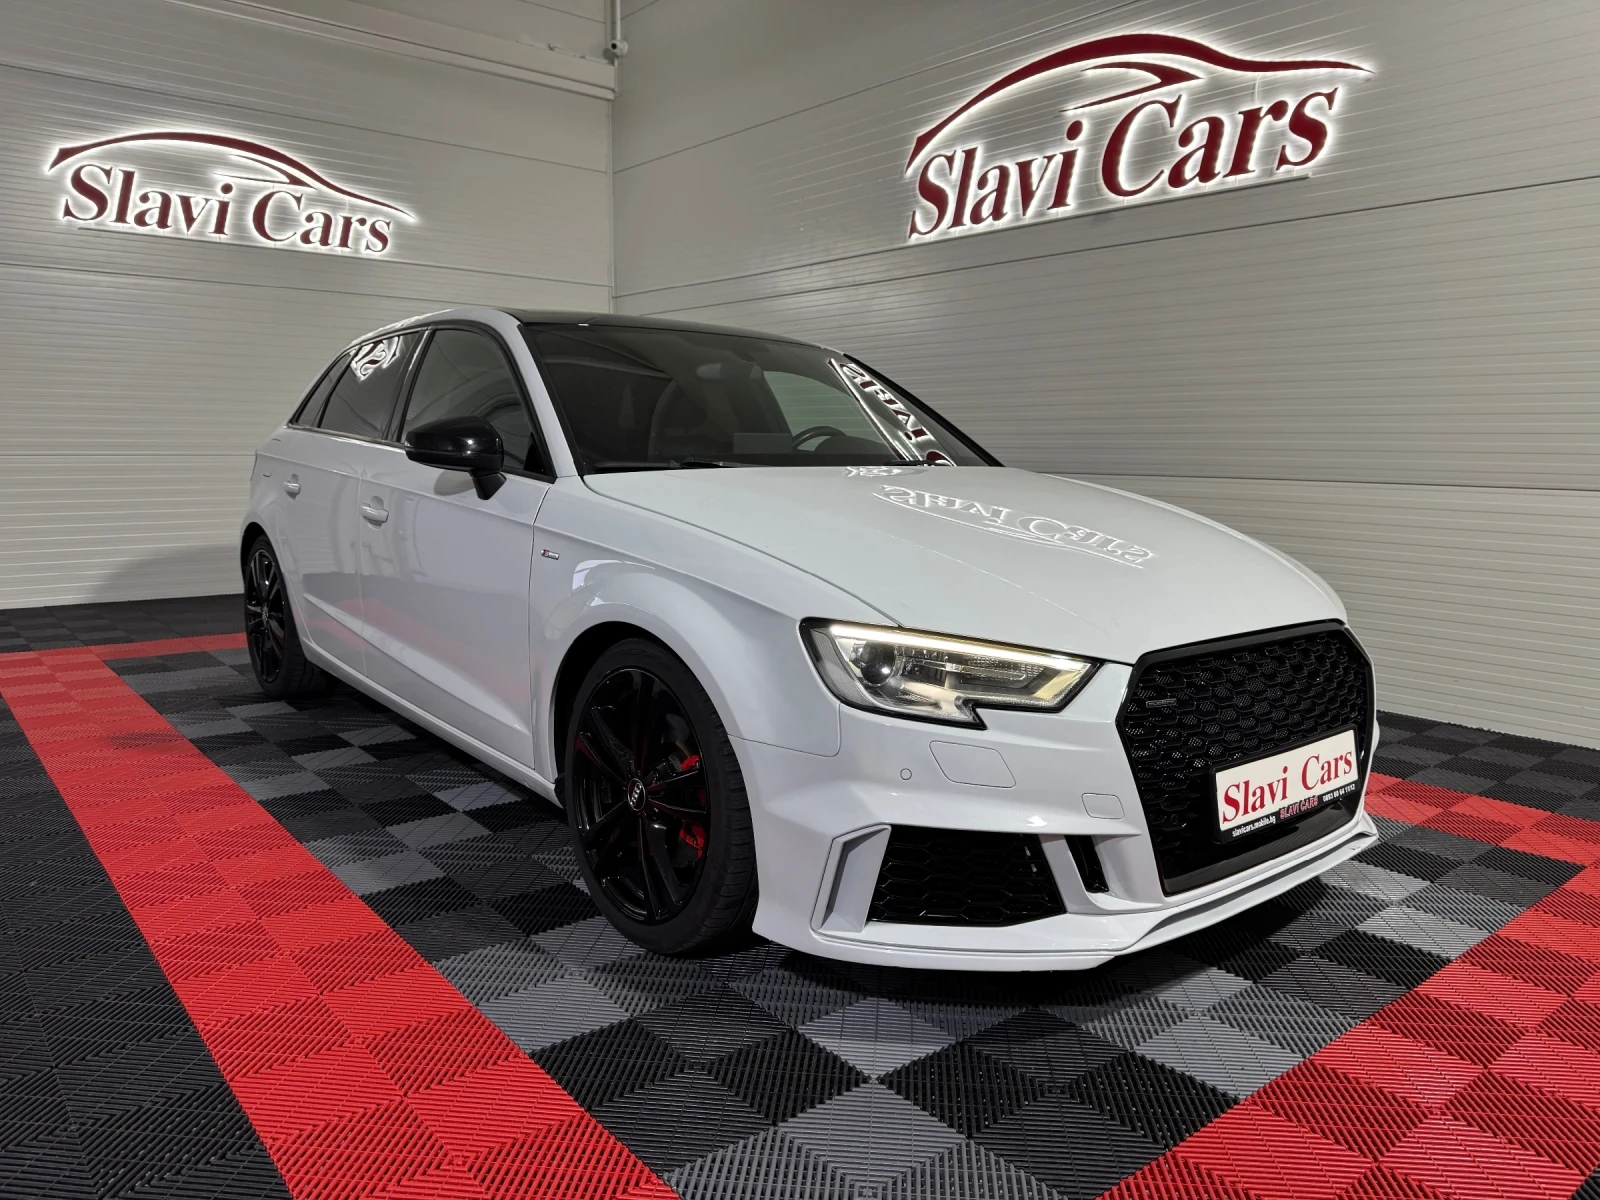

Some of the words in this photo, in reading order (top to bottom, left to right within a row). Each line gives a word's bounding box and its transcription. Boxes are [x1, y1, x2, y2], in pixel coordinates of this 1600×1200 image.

[907, 119, 1085, 239] Slavi
[1101, 86, 1339, 198] Cars
[62, 163, 235, 237] Slavi
[252, 189, 393, 254] Cars
[1222, 765, 1289, 825] Slavi
[1301, 750, 1353, 791] Cars
[1279, 802, 1300, 820] SLAVI
[1300, 795, 1319, 812] CARS
[1232, 815, 1276, 838] slavicars.mobile.bg
